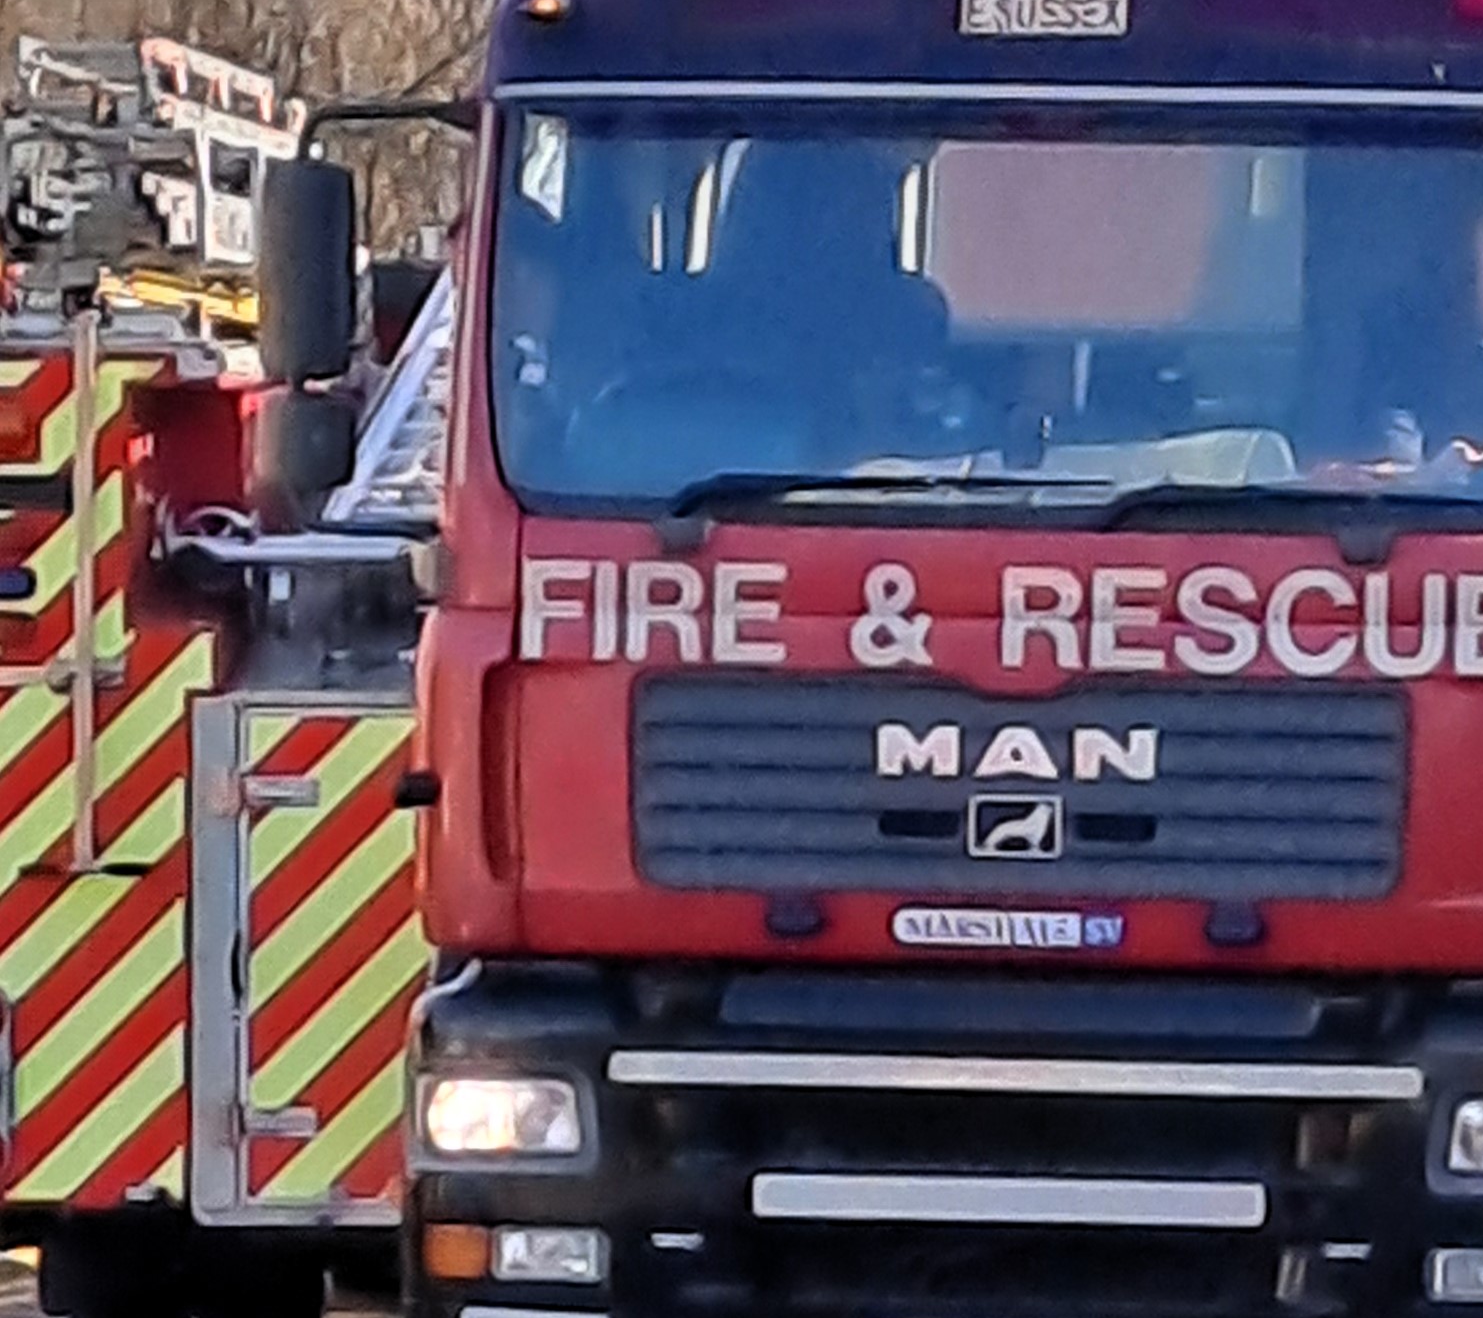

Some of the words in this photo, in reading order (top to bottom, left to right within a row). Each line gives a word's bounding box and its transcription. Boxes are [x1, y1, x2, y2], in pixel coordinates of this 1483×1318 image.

[520, 556, 788, 663] FIRE
[850, 561, 934, 666] &
[877, 724, 1159, 780] MAN
